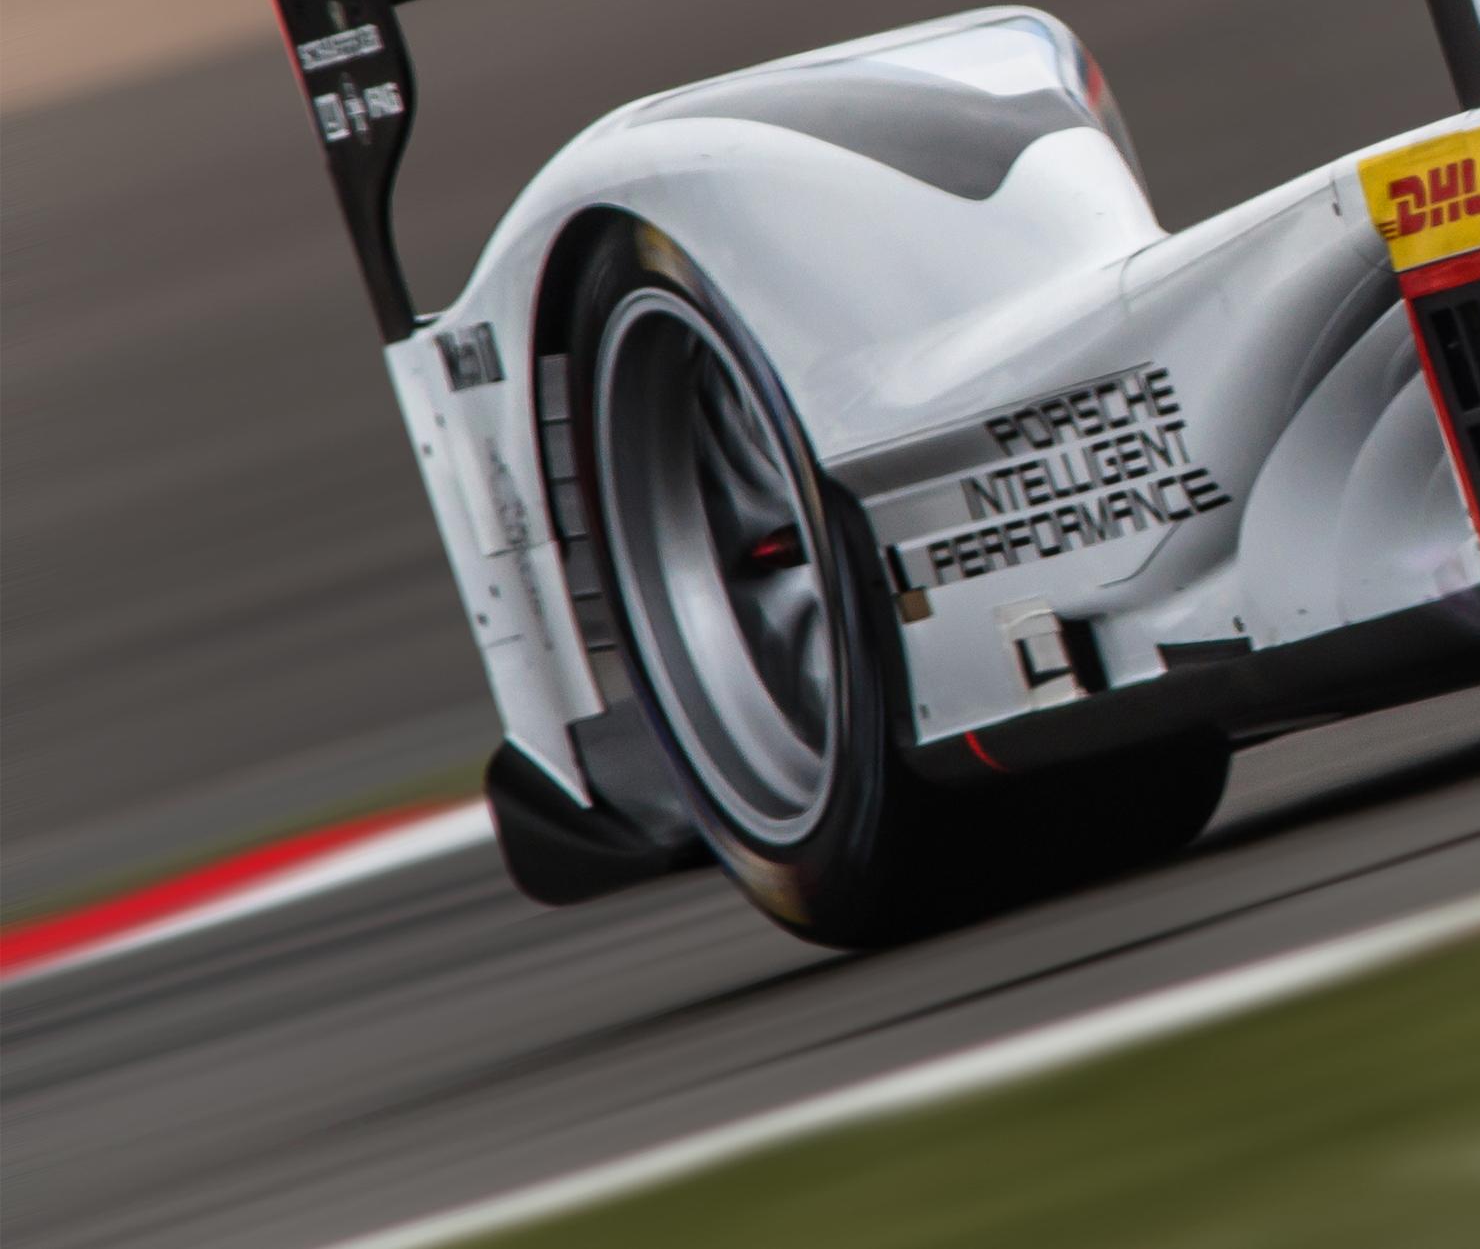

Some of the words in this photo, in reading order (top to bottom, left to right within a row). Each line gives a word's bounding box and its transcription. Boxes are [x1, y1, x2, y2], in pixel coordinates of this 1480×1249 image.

[985, 367, 1182, 457] PORSCHE
[961, 420, 1190, 521] INTELLIGENT
[926, 467, 1233, 585] PERFORMANCE
